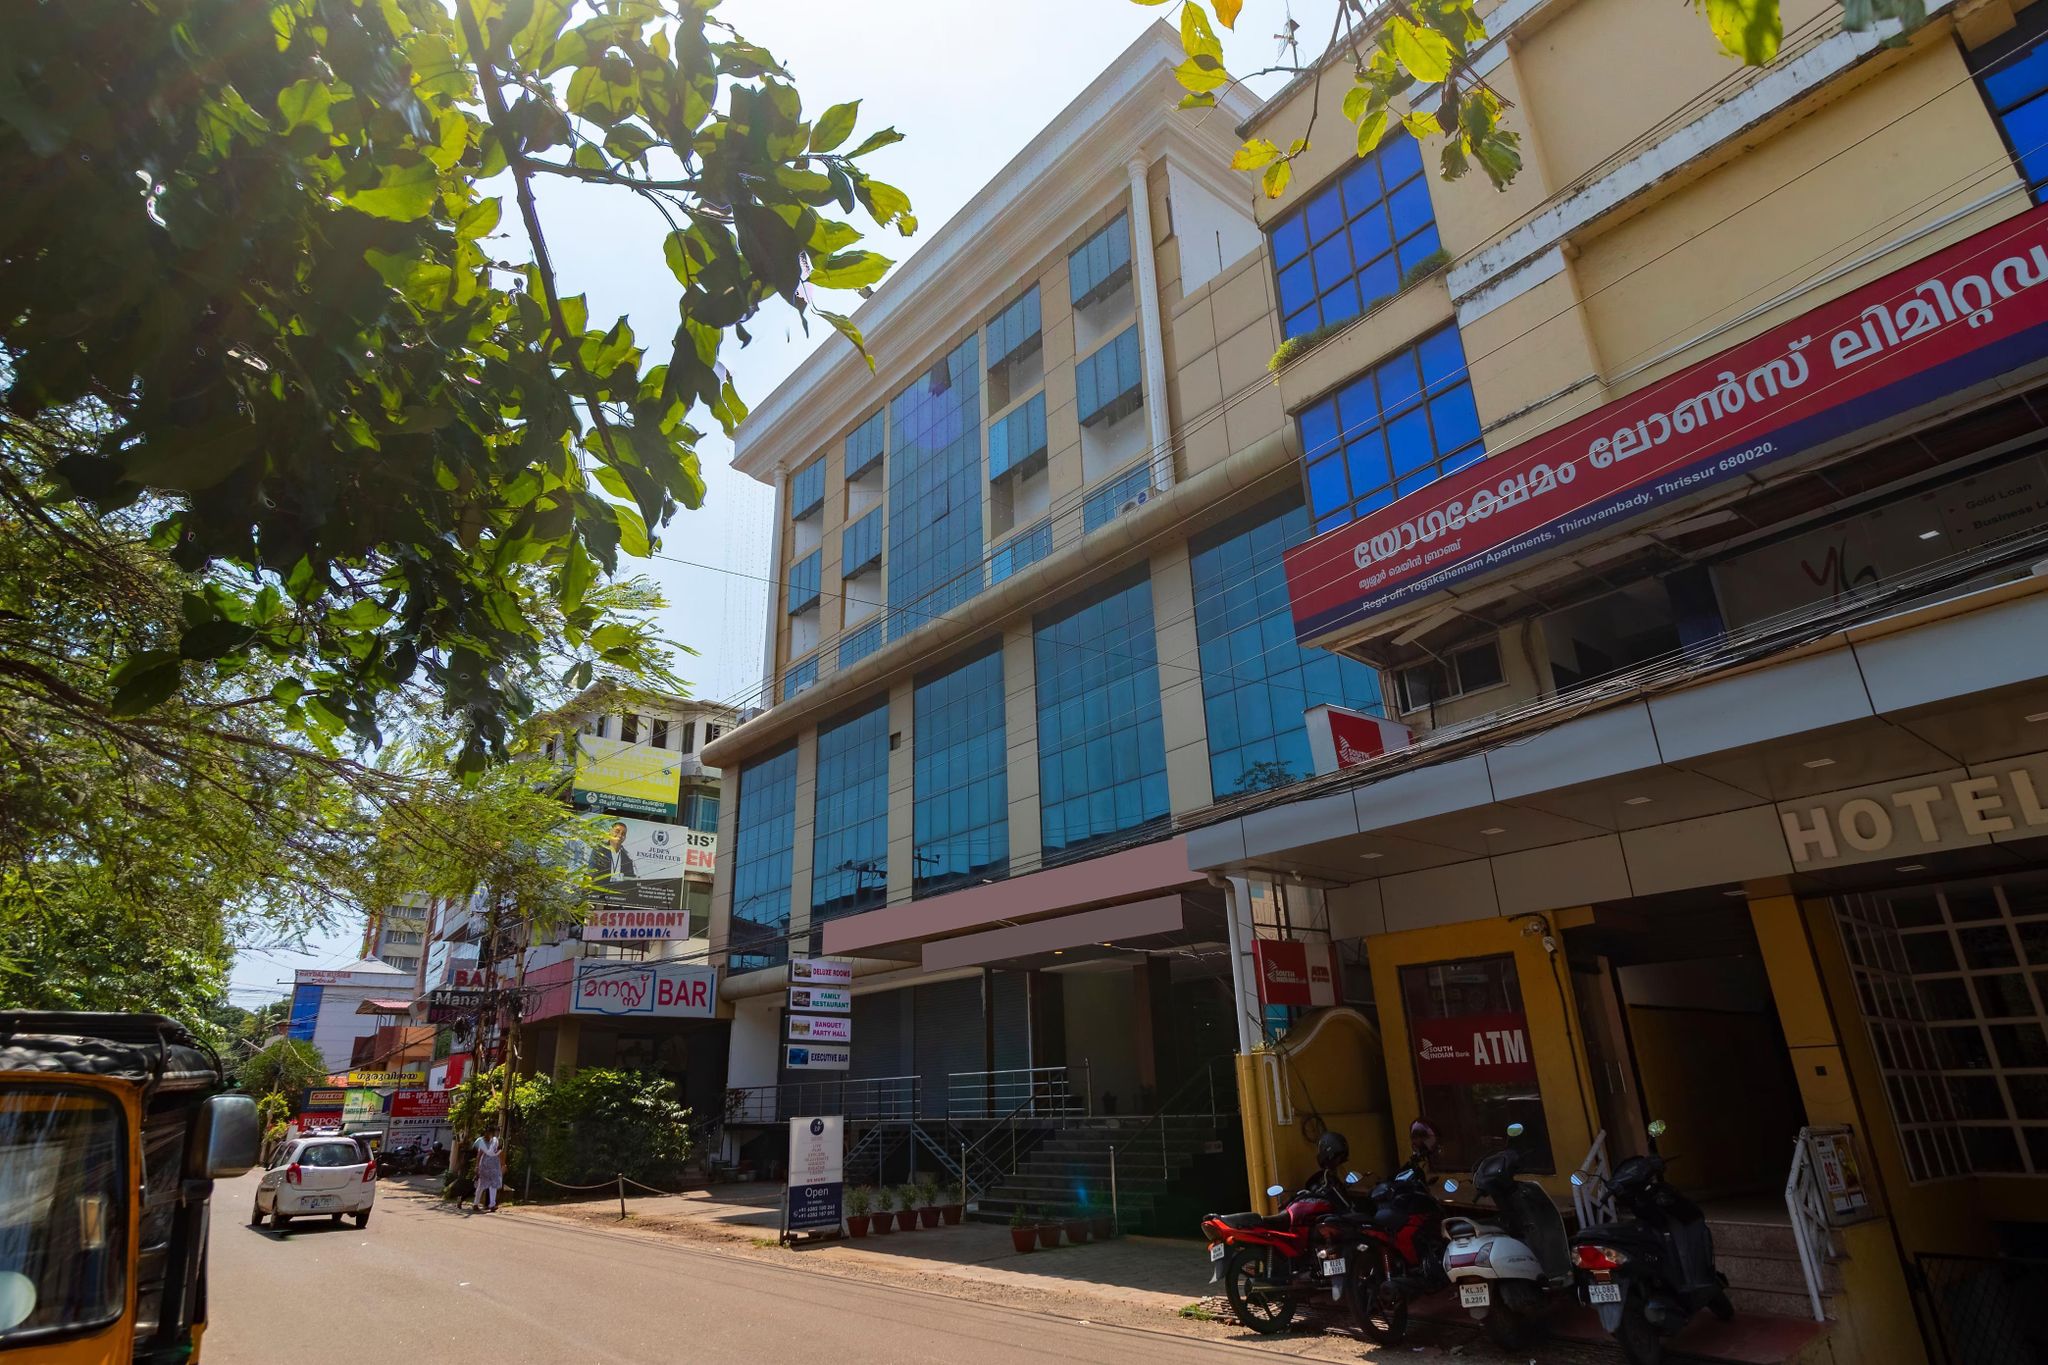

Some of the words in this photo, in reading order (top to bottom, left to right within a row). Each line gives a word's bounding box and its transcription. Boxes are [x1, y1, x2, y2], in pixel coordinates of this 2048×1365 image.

[1353, 461, 1577, 570] യോഗക്ഷേമം
[1829, 243, 2048, 371] ലിമിറ്റഡ
[1966, 495, 1996, 510] Gold
[1998, 483, 2032, 500] Loan
[1362, 594, 1387, 612] Regd
[1408, 558, 1484, 595] Yogakshemam
[1485, 528, 1557, 569] Apartments,
[1557, 493, 1655, 535] Thiruvambady,
[1655, 465, 1718, 498] Thrissur
[1718, 441, 1779, 471] 680020.
[1781, 768, 2048, 864] HOTEL
[636, 851, 664, 860] ENGLISH
[685, 848, 717, 869] EN
[813, 967, 833, 977] DELUXE
[833, 969, 851, 978] ROOMS
[657, 979, 707, 1008] BAR
[820, 992, 841, 1000] FAMILY
[811, 1000, 850, 1009] RESTAURANT
[815, 1021, 842, 1029] BANQUET
[1429, 1045, 1453, 1053] SOUTH
[1473, 1029, 1528, 1066] ATM
[811, 1052, 838, 1062] EXECUTIVE
[838, 1054, 849, 1063] BAR
[1455, 1050, 1470, 1058] Bank
[303, 1117, 341, 1127] REPOS
[805, 1187, 829, 1199] Open
